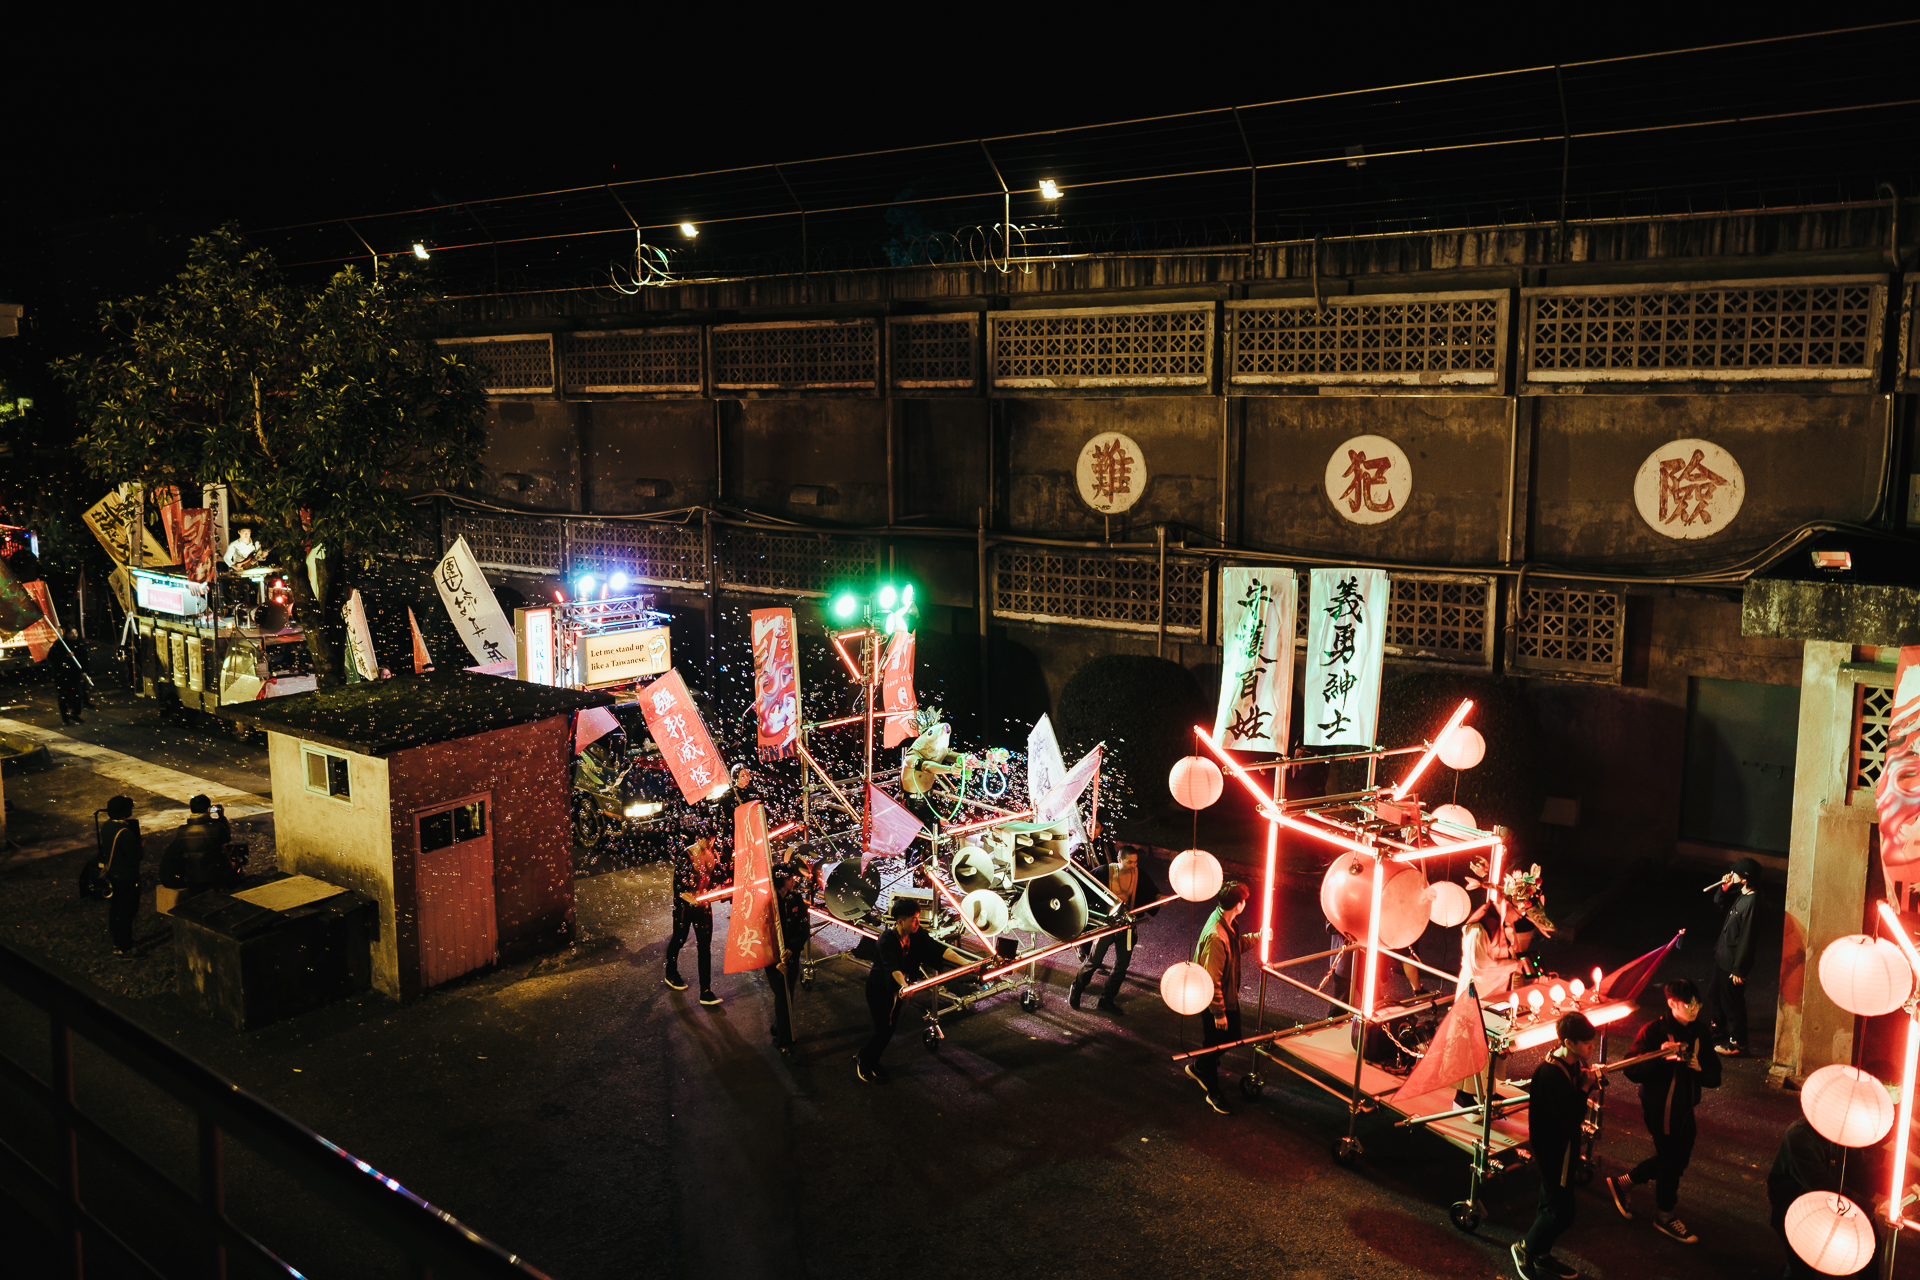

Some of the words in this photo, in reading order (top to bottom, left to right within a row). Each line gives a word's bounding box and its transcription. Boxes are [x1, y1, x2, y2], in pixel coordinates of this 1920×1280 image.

[1092, 438, 1135, 504] 難
[1338, 449, 1394, 513] 犯
[1659, 448, 1729, 525] 險
[534, 623, 545, 684] 台灣民族
[591, 650, 602, 658] Let
[615, 644, 634, 653] stand
[635, 643, 644, 652] up
[591, 662, 604, 671] like
[611, 657, 647, 667] Taiwanese.
[1317, 576, 1366, 740] 義勇紳士
